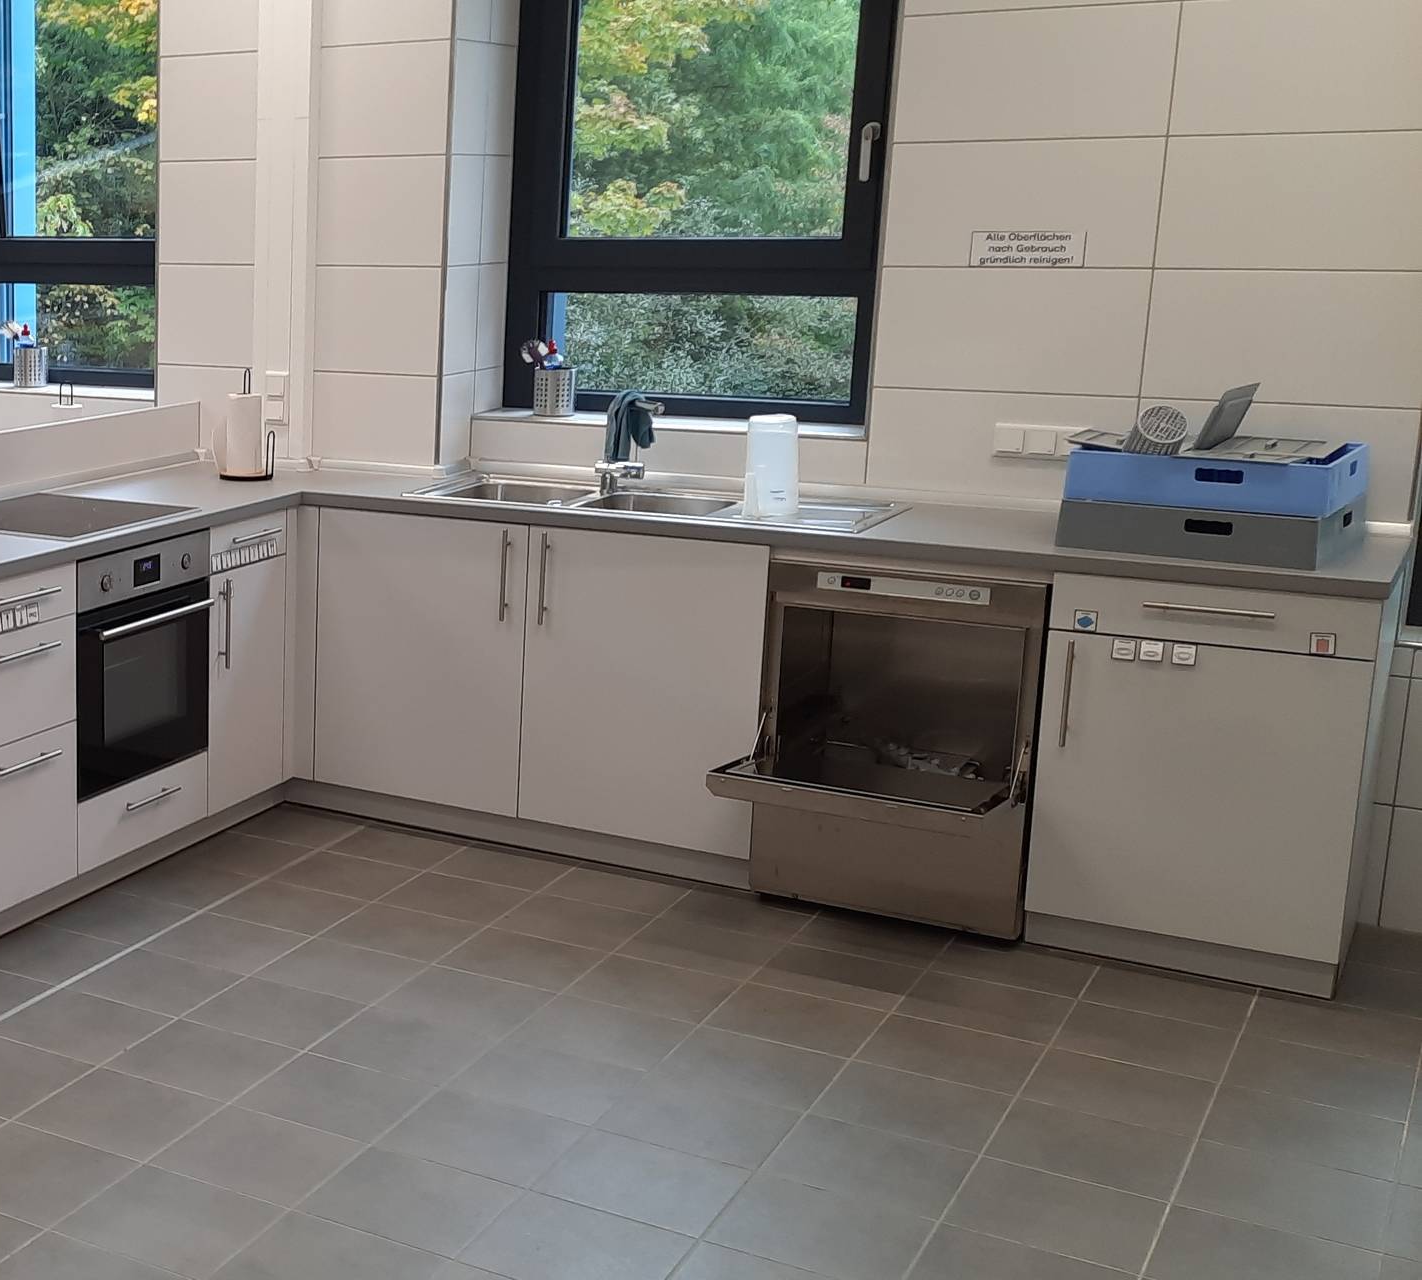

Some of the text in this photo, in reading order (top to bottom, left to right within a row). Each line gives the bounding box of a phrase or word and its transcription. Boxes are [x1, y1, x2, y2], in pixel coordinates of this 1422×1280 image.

[986, 232, 1071, 241] Alle Oberflächen
[1016, 244, 1066, 252] Gebrauch
[979, 255, 1074, 265] gründlich reinigen!
